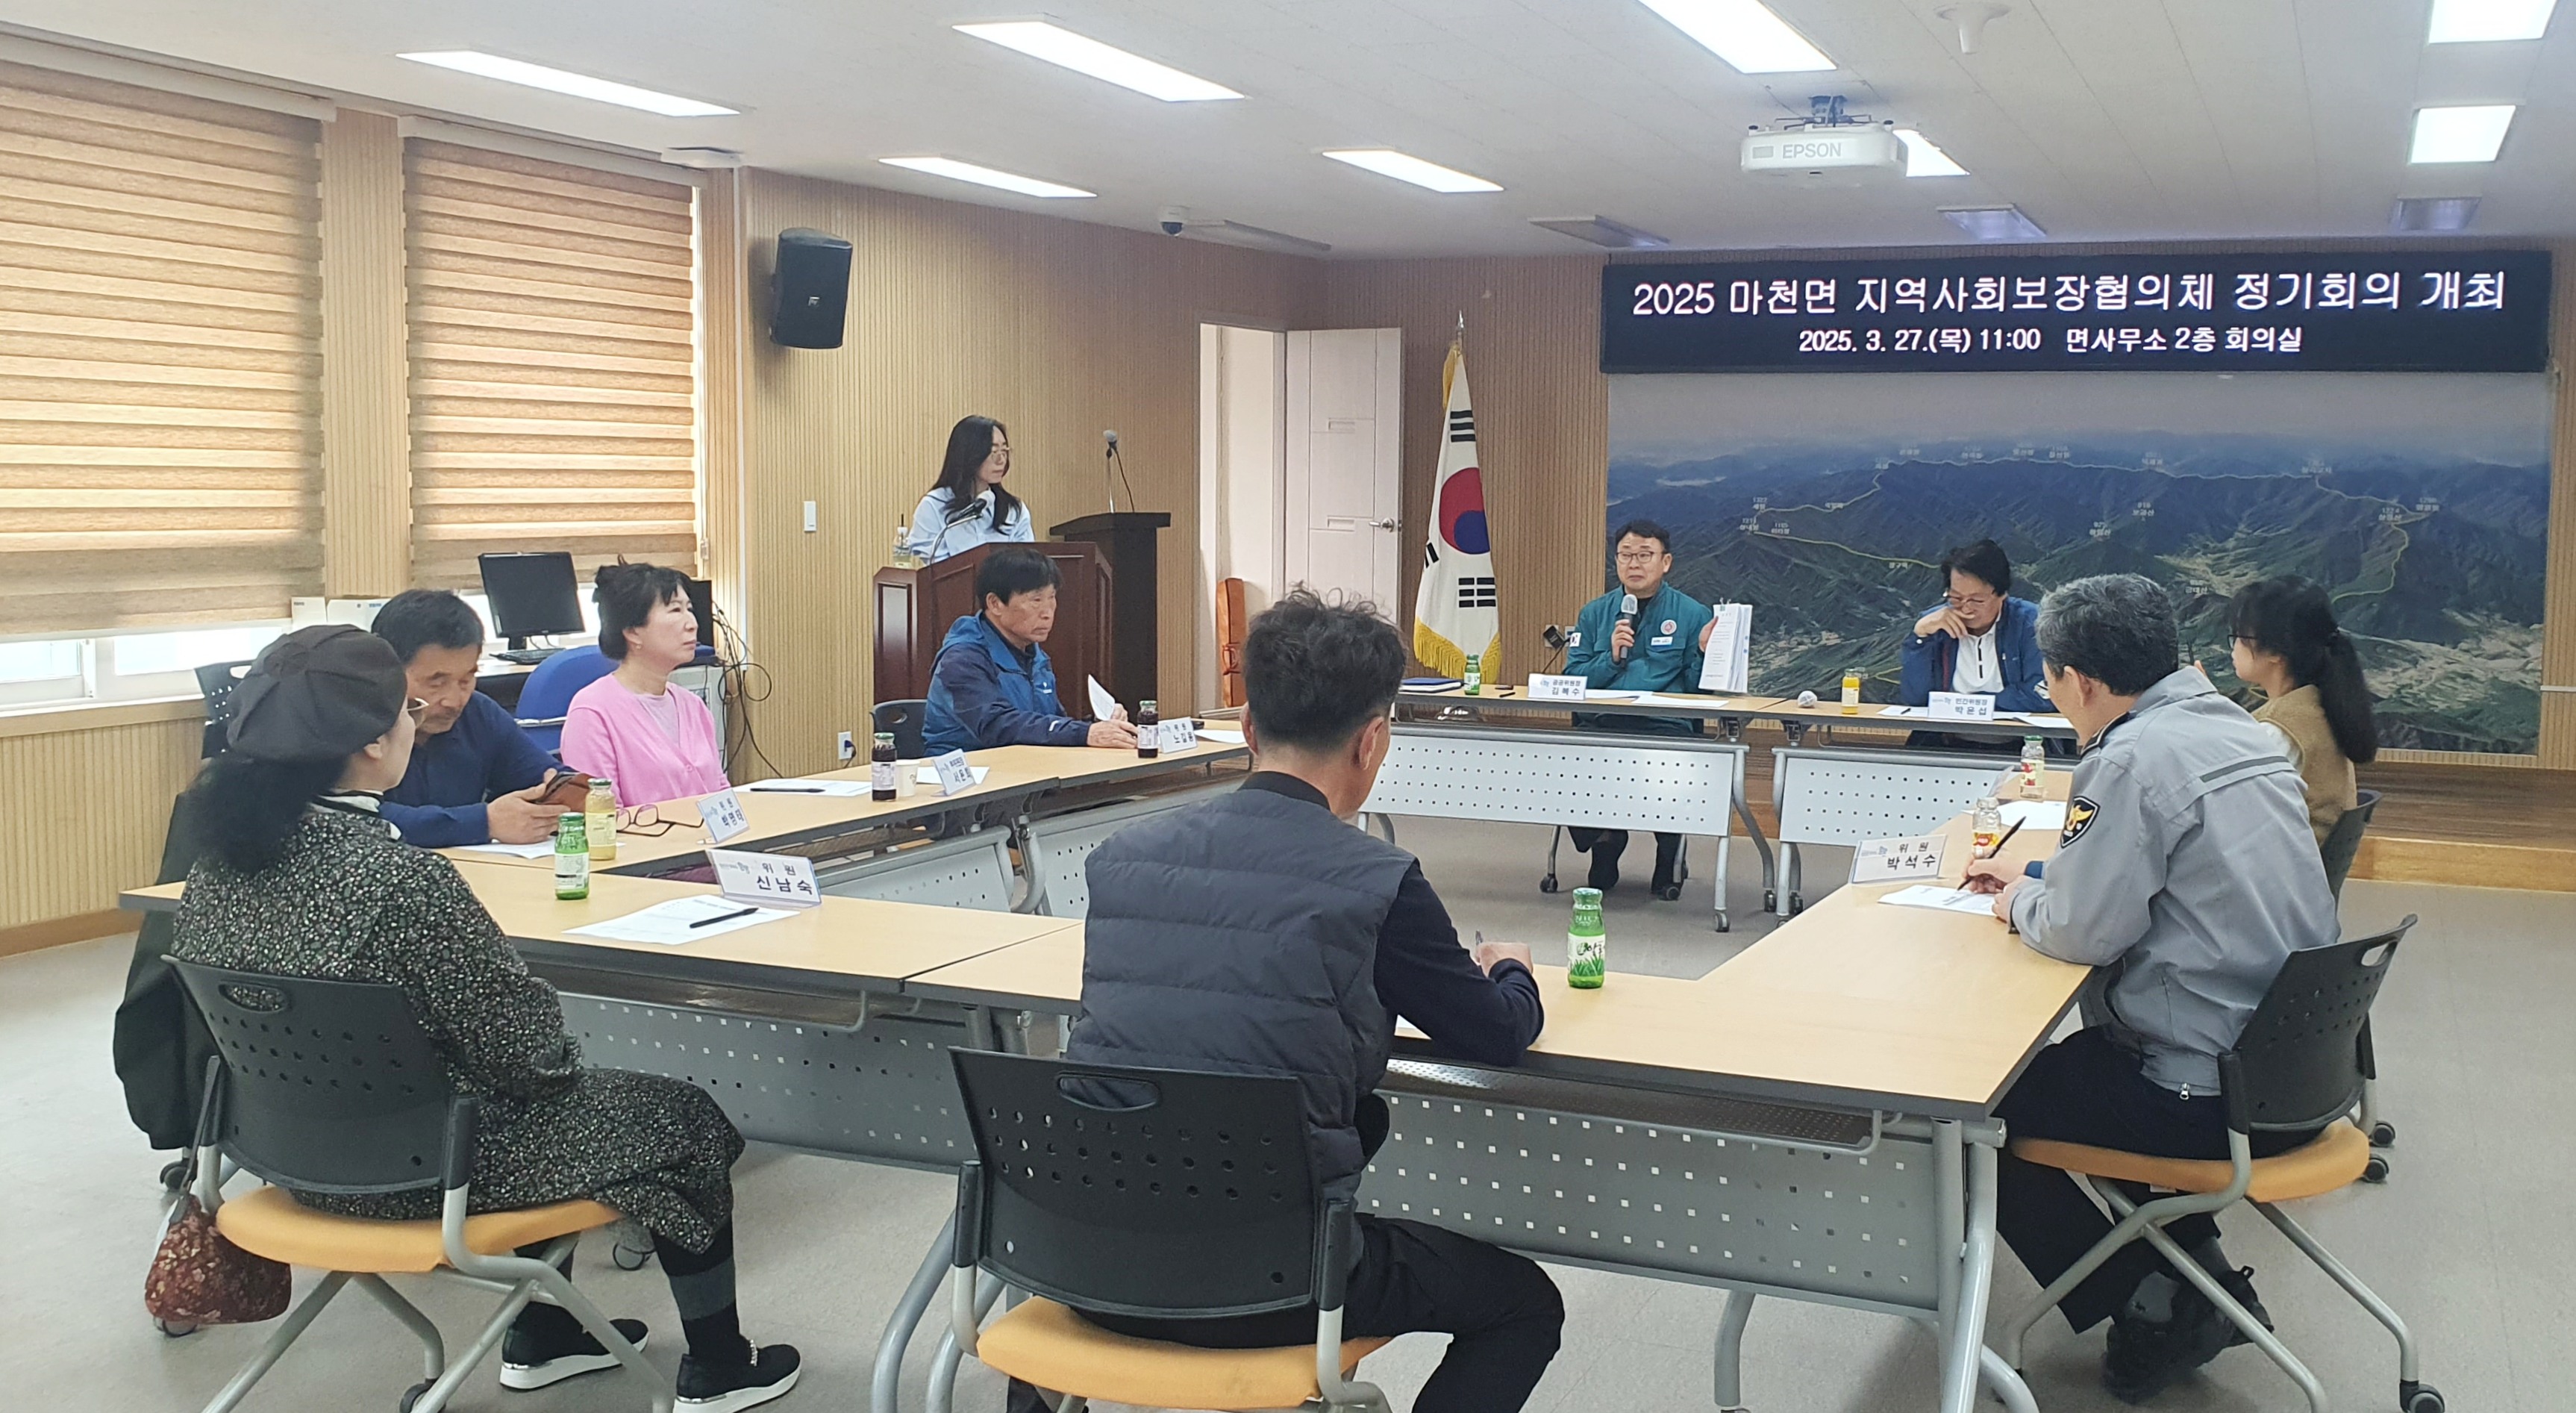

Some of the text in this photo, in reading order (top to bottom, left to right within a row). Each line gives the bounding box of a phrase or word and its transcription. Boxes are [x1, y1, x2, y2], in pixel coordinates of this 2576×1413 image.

[1782, 143, 1842, 159] EPSON
[1632, 271, 2505, 316] 2025 마천면 지역사회보장협의체 정기회의 개최
[1799, 326, 2302, 353] 2025. 3. 27.(목) 11:00 면사무소 2층 회의실
